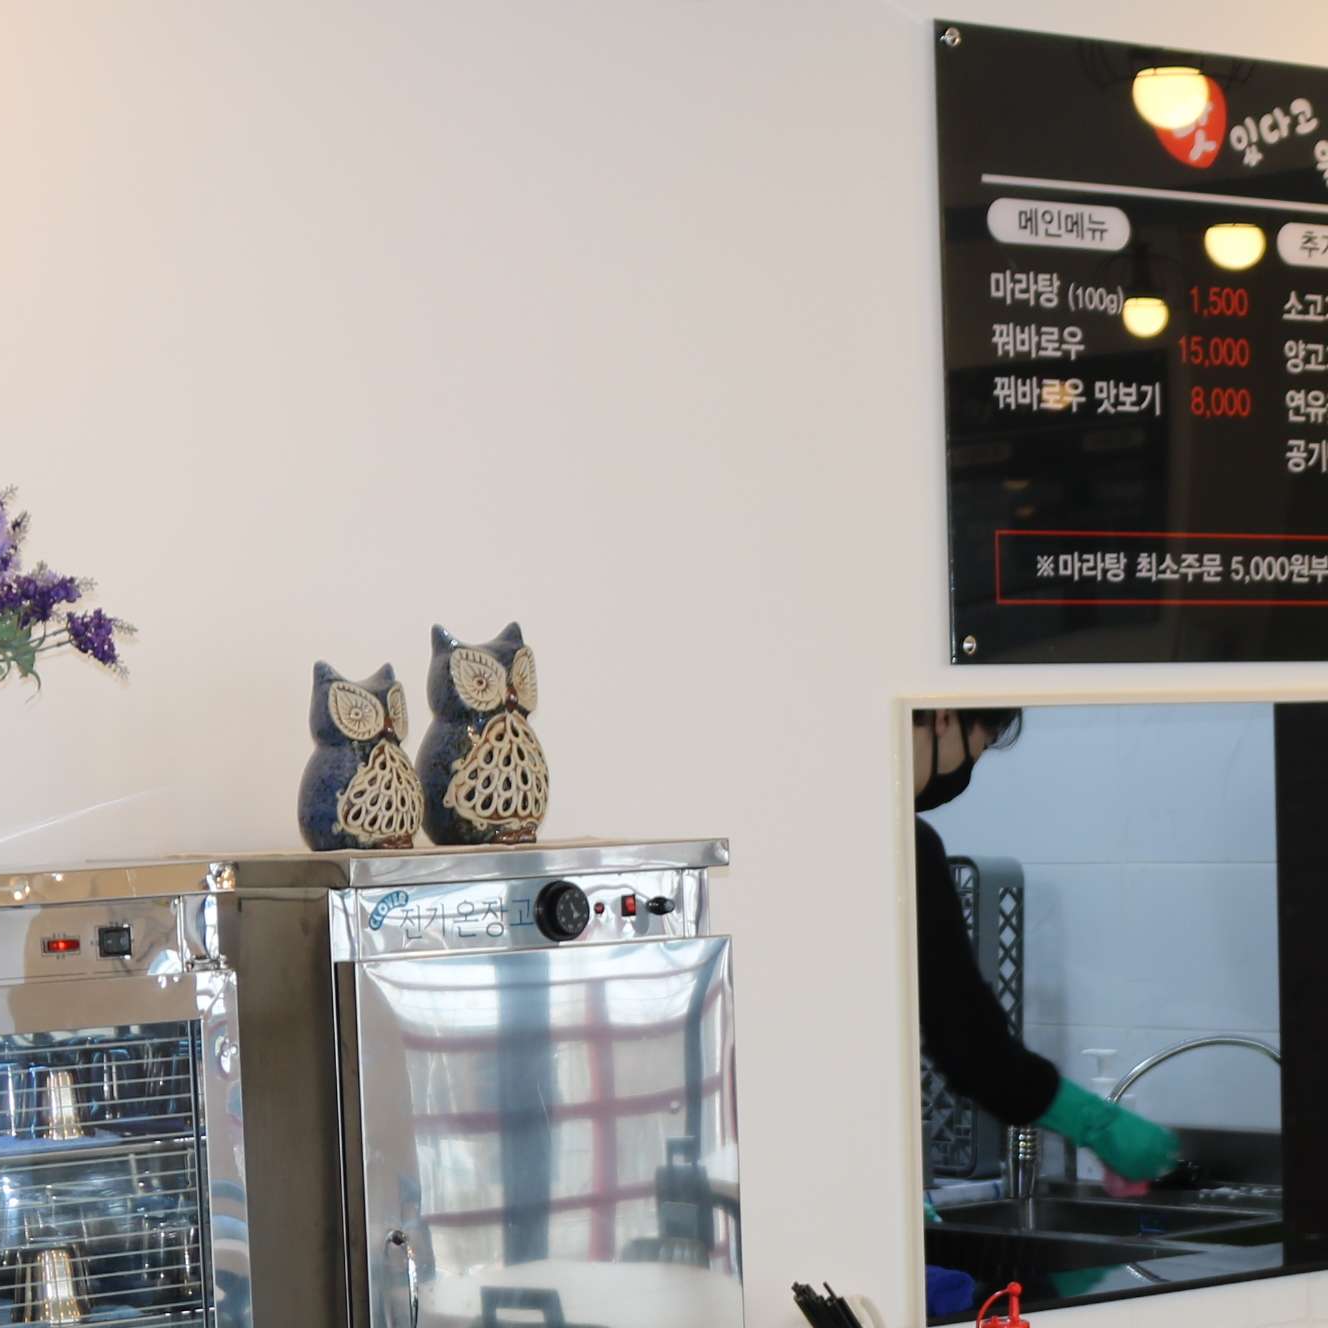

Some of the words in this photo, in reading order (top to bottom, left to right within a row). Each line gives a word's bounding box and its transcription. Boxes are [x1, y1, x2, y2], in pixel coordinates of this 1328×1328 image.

[1016, 207, 1110, 242] 메인메뉴
[990, 269, 1061, 309] 마라탕
[1067, 283, 1125, 317] (100g)
[1190, 286, 1250, 318] 1,500
[991, 322, 1086, 361] 꿔바로우
[1178, 335, 1252, 369] 15,000
[992, 375, 1087, 413] 꿔바로우
[1094, 379, 1161, 416] 맛보기
[1189, 385, 1253, 418] 8,000
[1135, 552, 1224, 583] 최소주문
